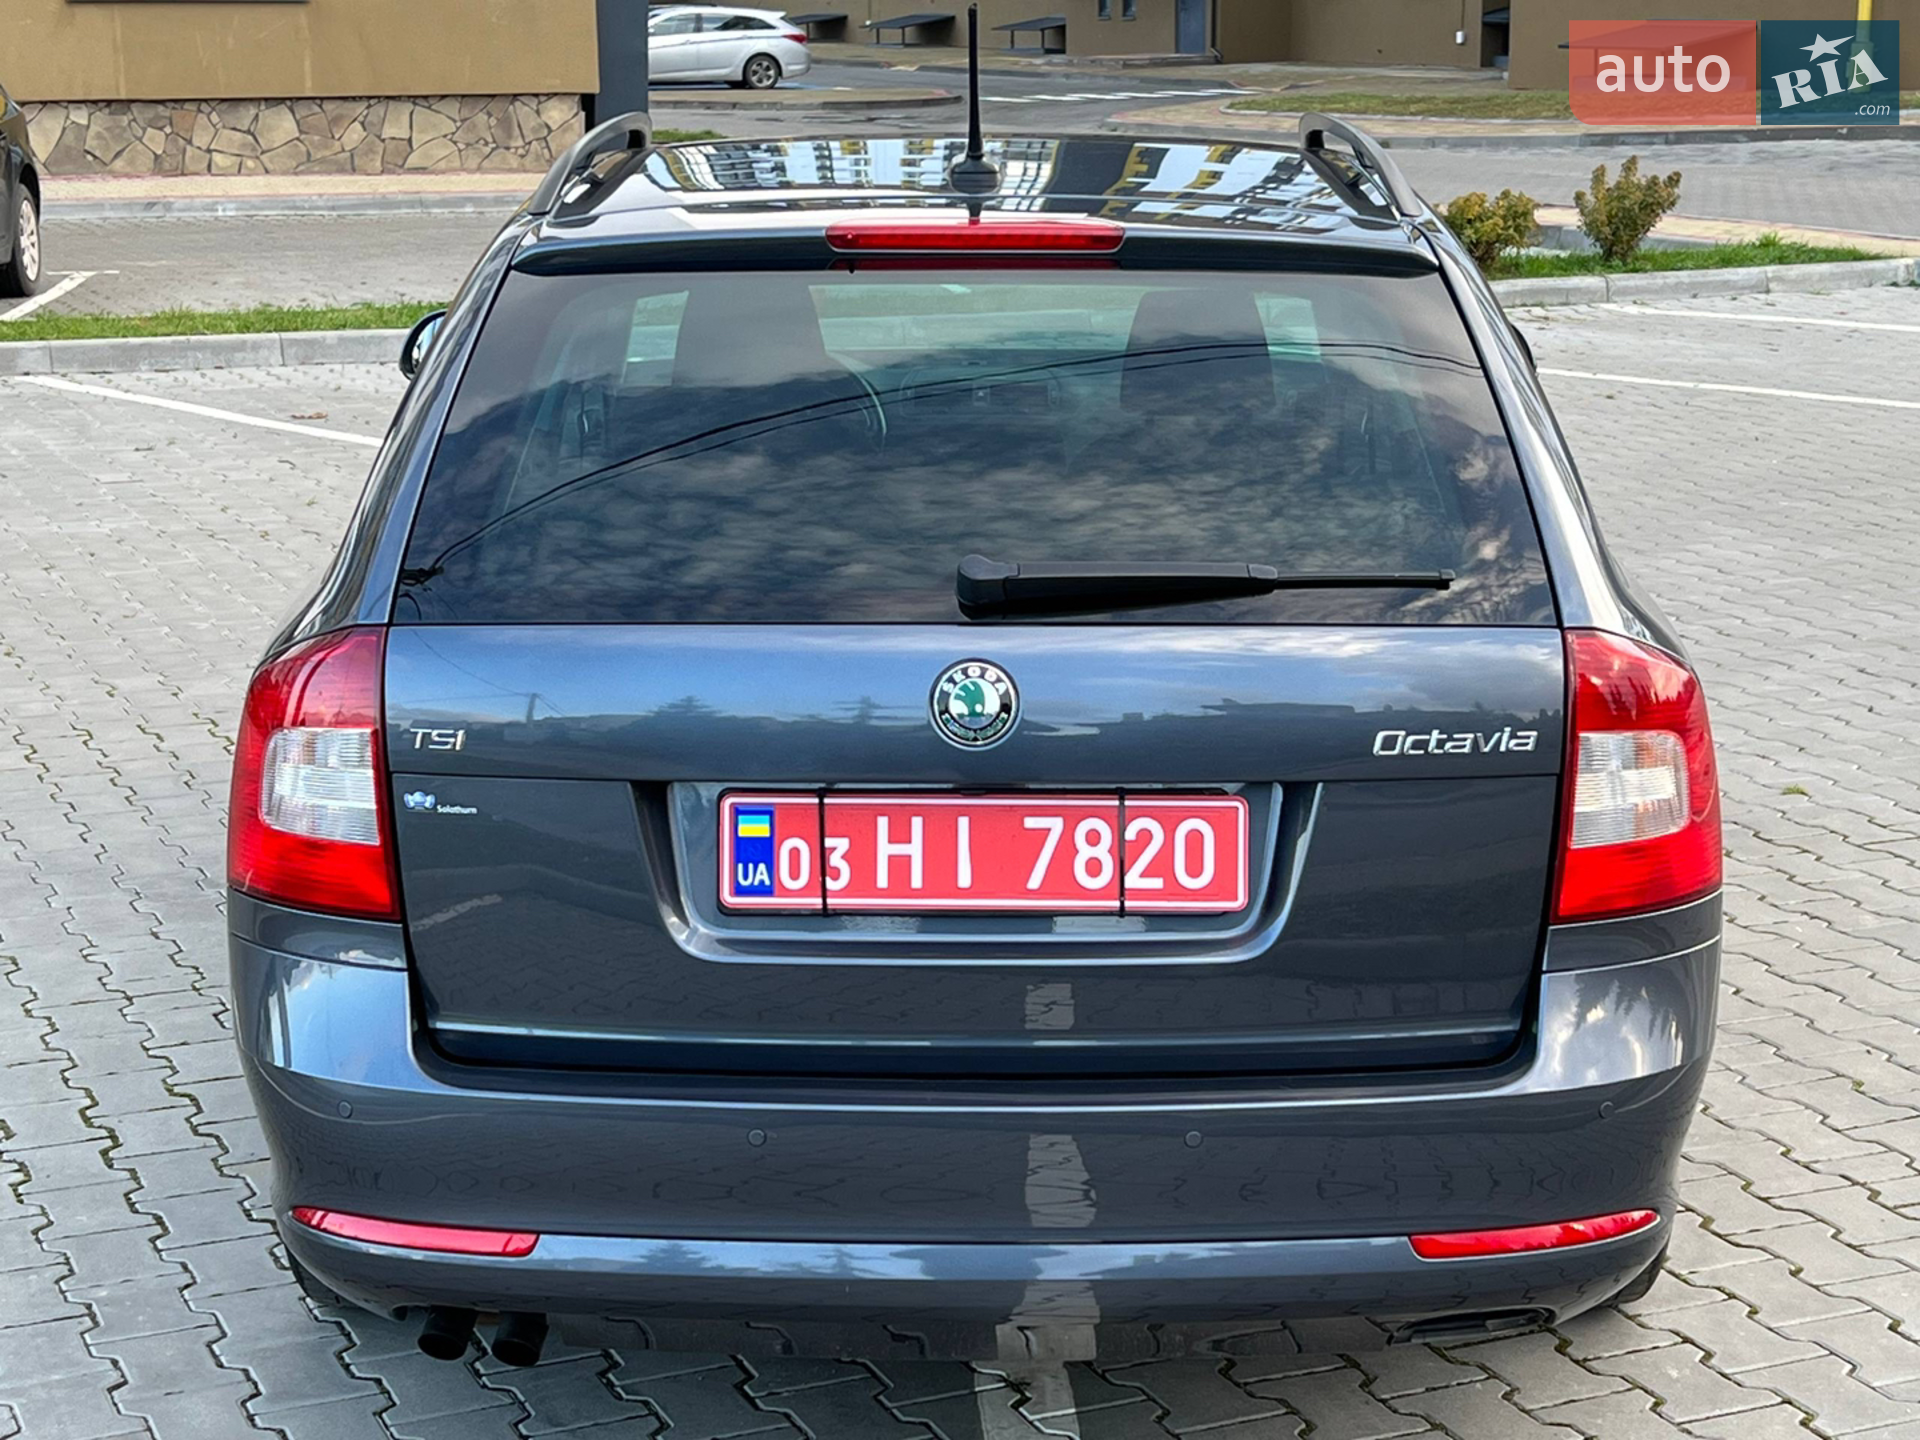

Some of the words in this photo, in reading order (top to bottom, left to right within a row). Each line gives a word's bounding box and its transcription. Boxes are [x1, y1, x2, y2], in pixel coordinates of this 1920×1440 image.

[1373, 727, 1538, 756] Octavia
[778, 836, 852, 891] 03
[1023, 816, 1216, 890] 7820
[737, 862, 771, 887] UA
